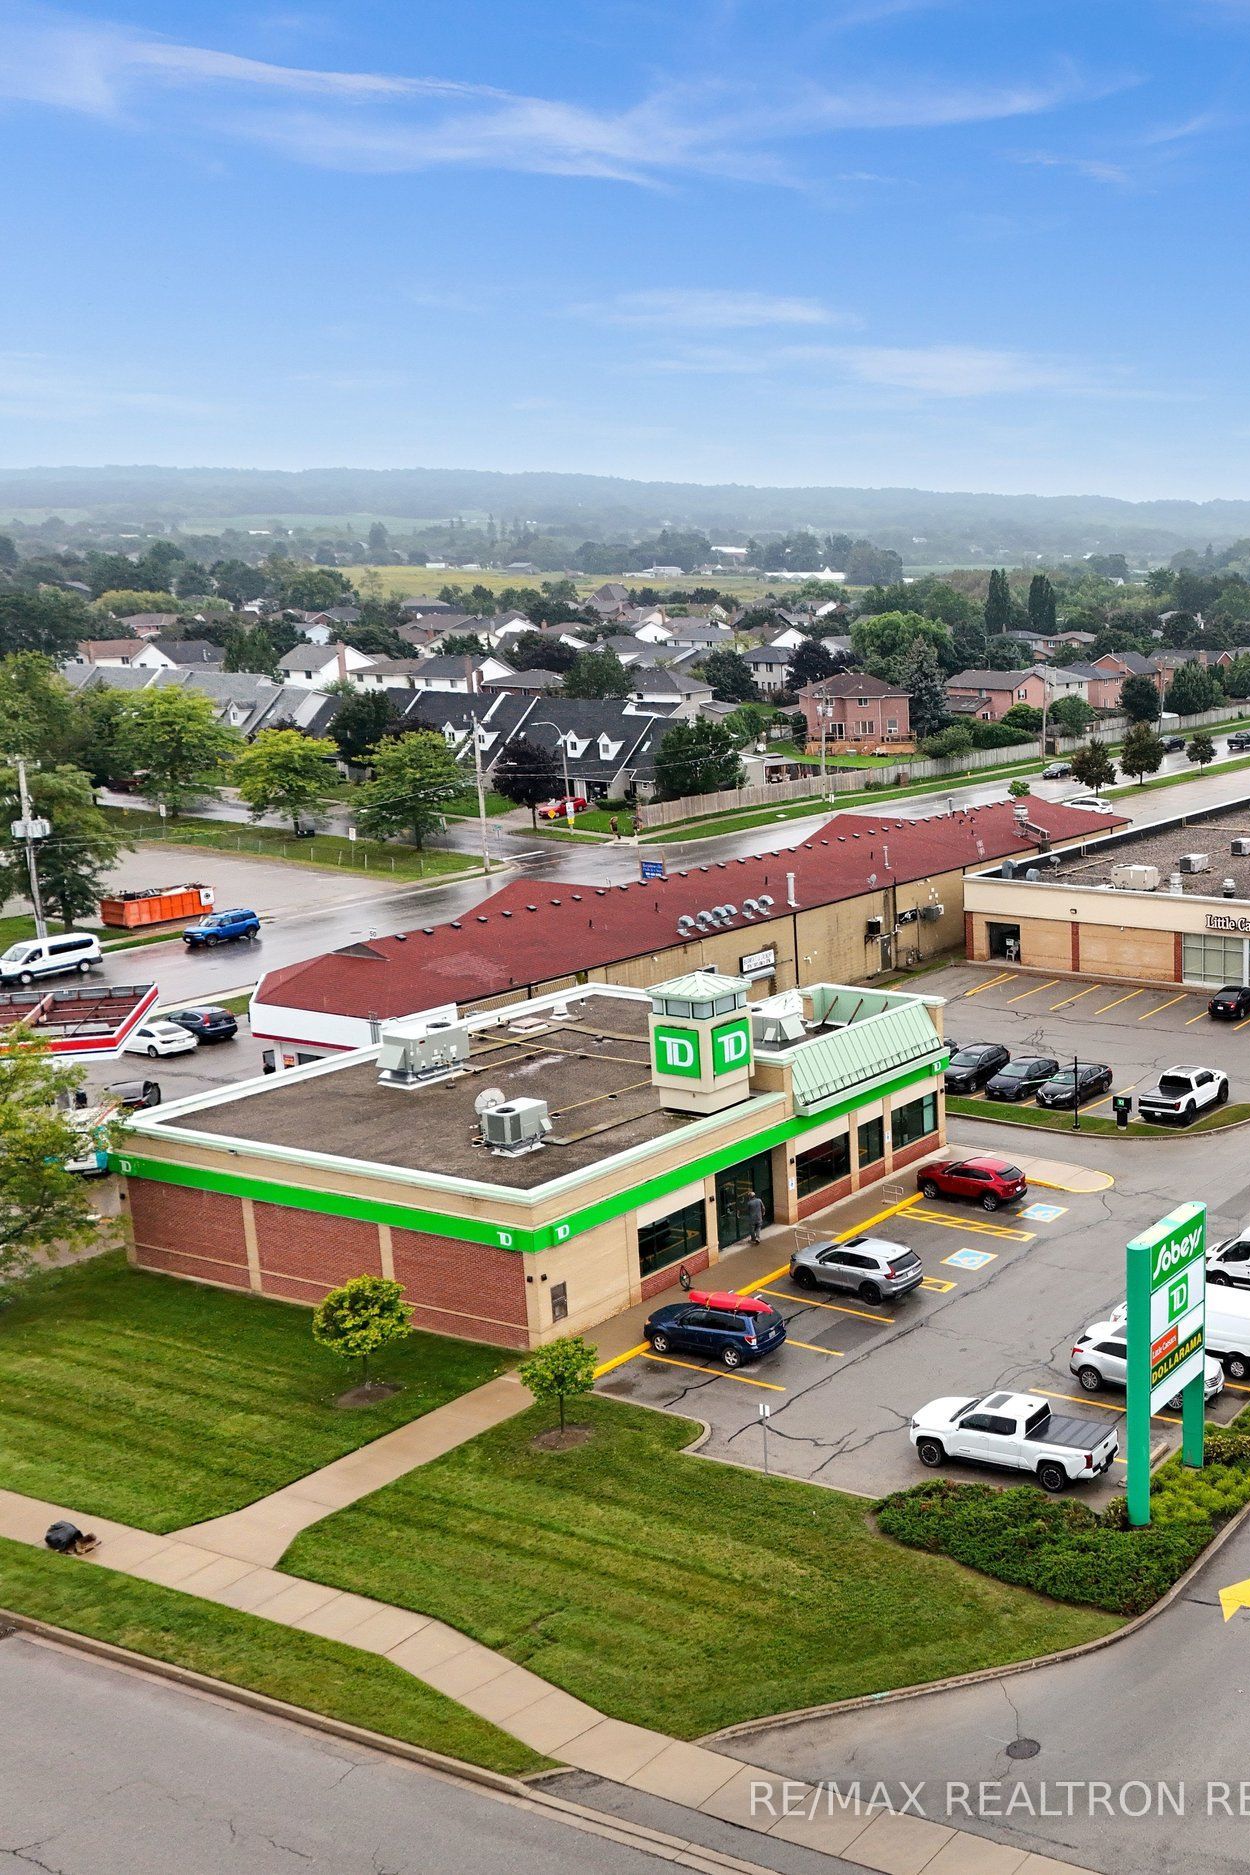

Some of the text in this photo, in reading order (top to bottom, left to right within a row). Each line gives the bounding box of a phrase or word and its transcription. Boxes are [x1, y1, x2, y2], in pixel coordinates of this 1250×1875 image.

[1205, 914, 1236, 930] Little
[659, 1036, 694, 1067] TD
[717, 1030, 747, 1063] TD
[118, 1160, 132, 1173] TD
[496, 1231, 512, 1247] TD
[555, 1224, 570, 1240] TD
[1152, 1225, 1203, 1280] Sobeys
[1170, 1283, 1187, 1312] TD
[1151, 1332, 1202, 1384] DOLLARAMA
